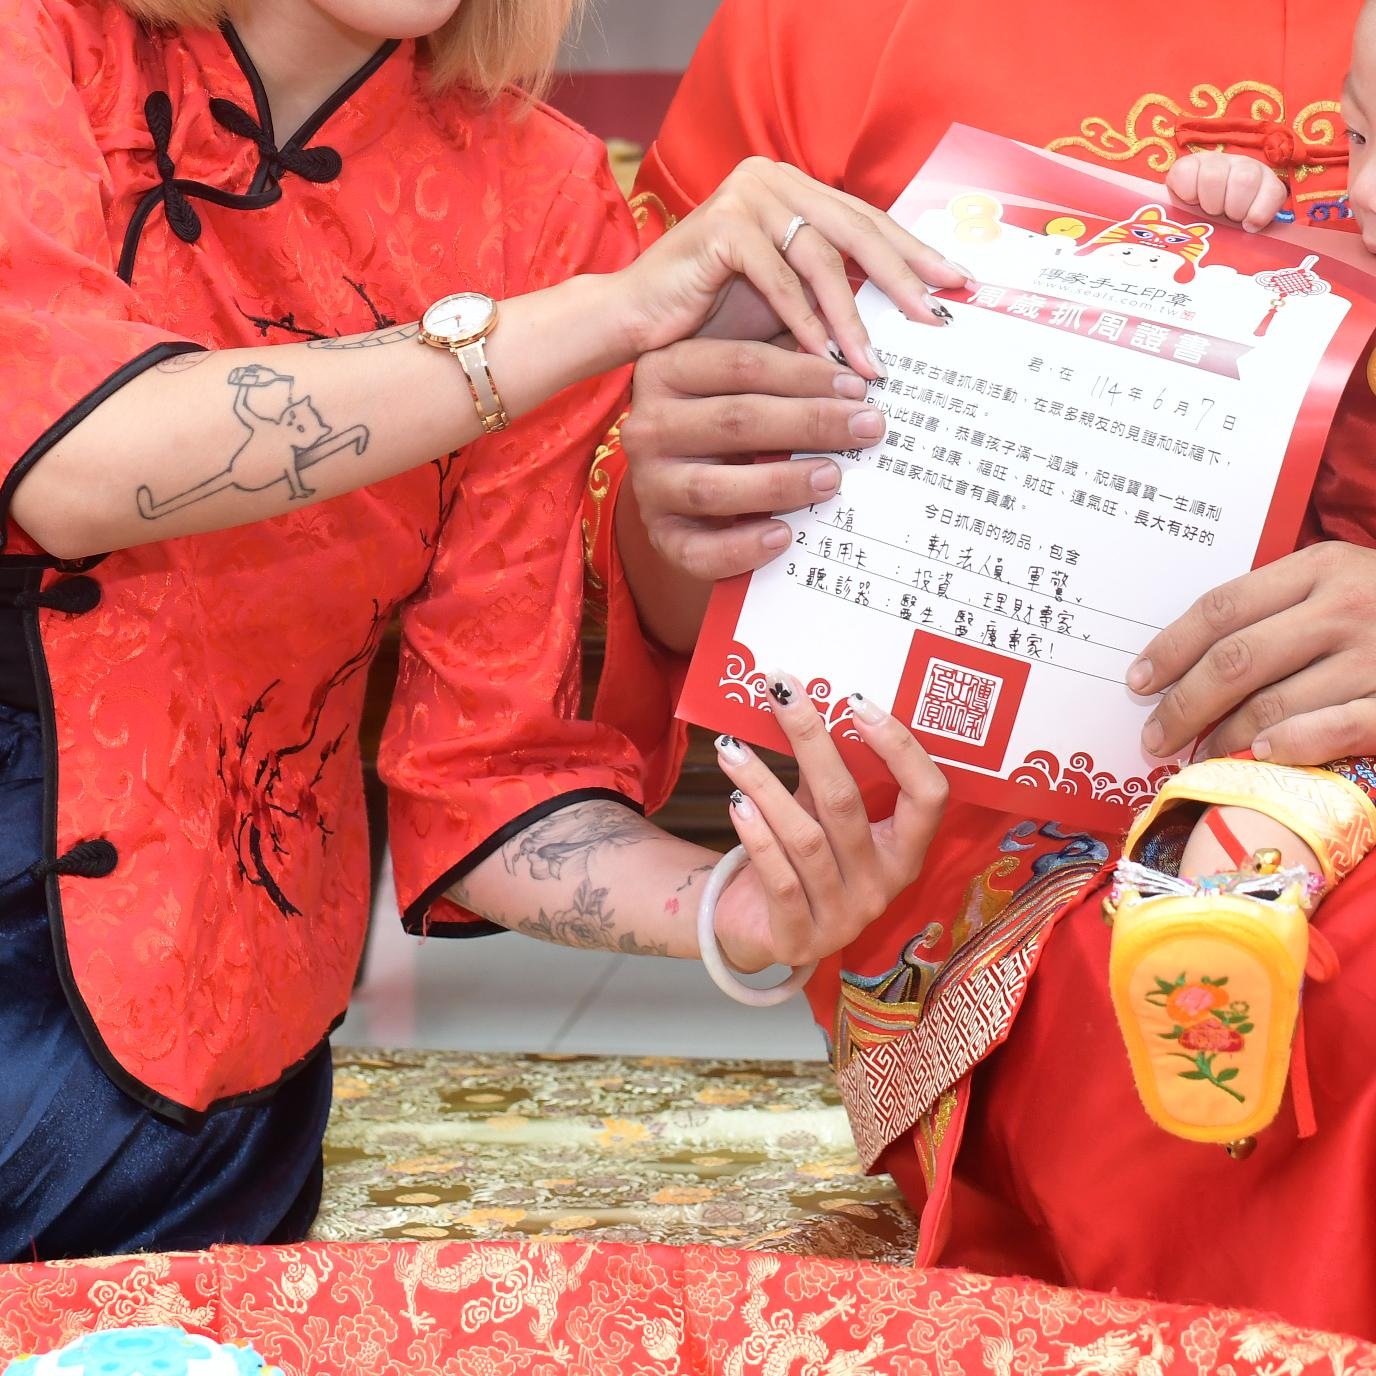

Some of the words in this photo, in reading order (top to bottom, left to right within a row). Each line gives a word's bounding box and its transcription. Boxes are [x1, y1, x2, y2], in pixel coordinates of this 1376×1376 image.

[1032, 279, 1179, 317] www.seals.com.tw
[1038, 267, 1193, 307] 傳家手工印章
[966, 284, 1212, 364] 周歲抓周證書
[795, 531, 808, 546] 2.
[818, 535, 868, 569] 信用卡
[786, 562, 798, 577] 3.
[805, 567, 872, 607] 聽診器
